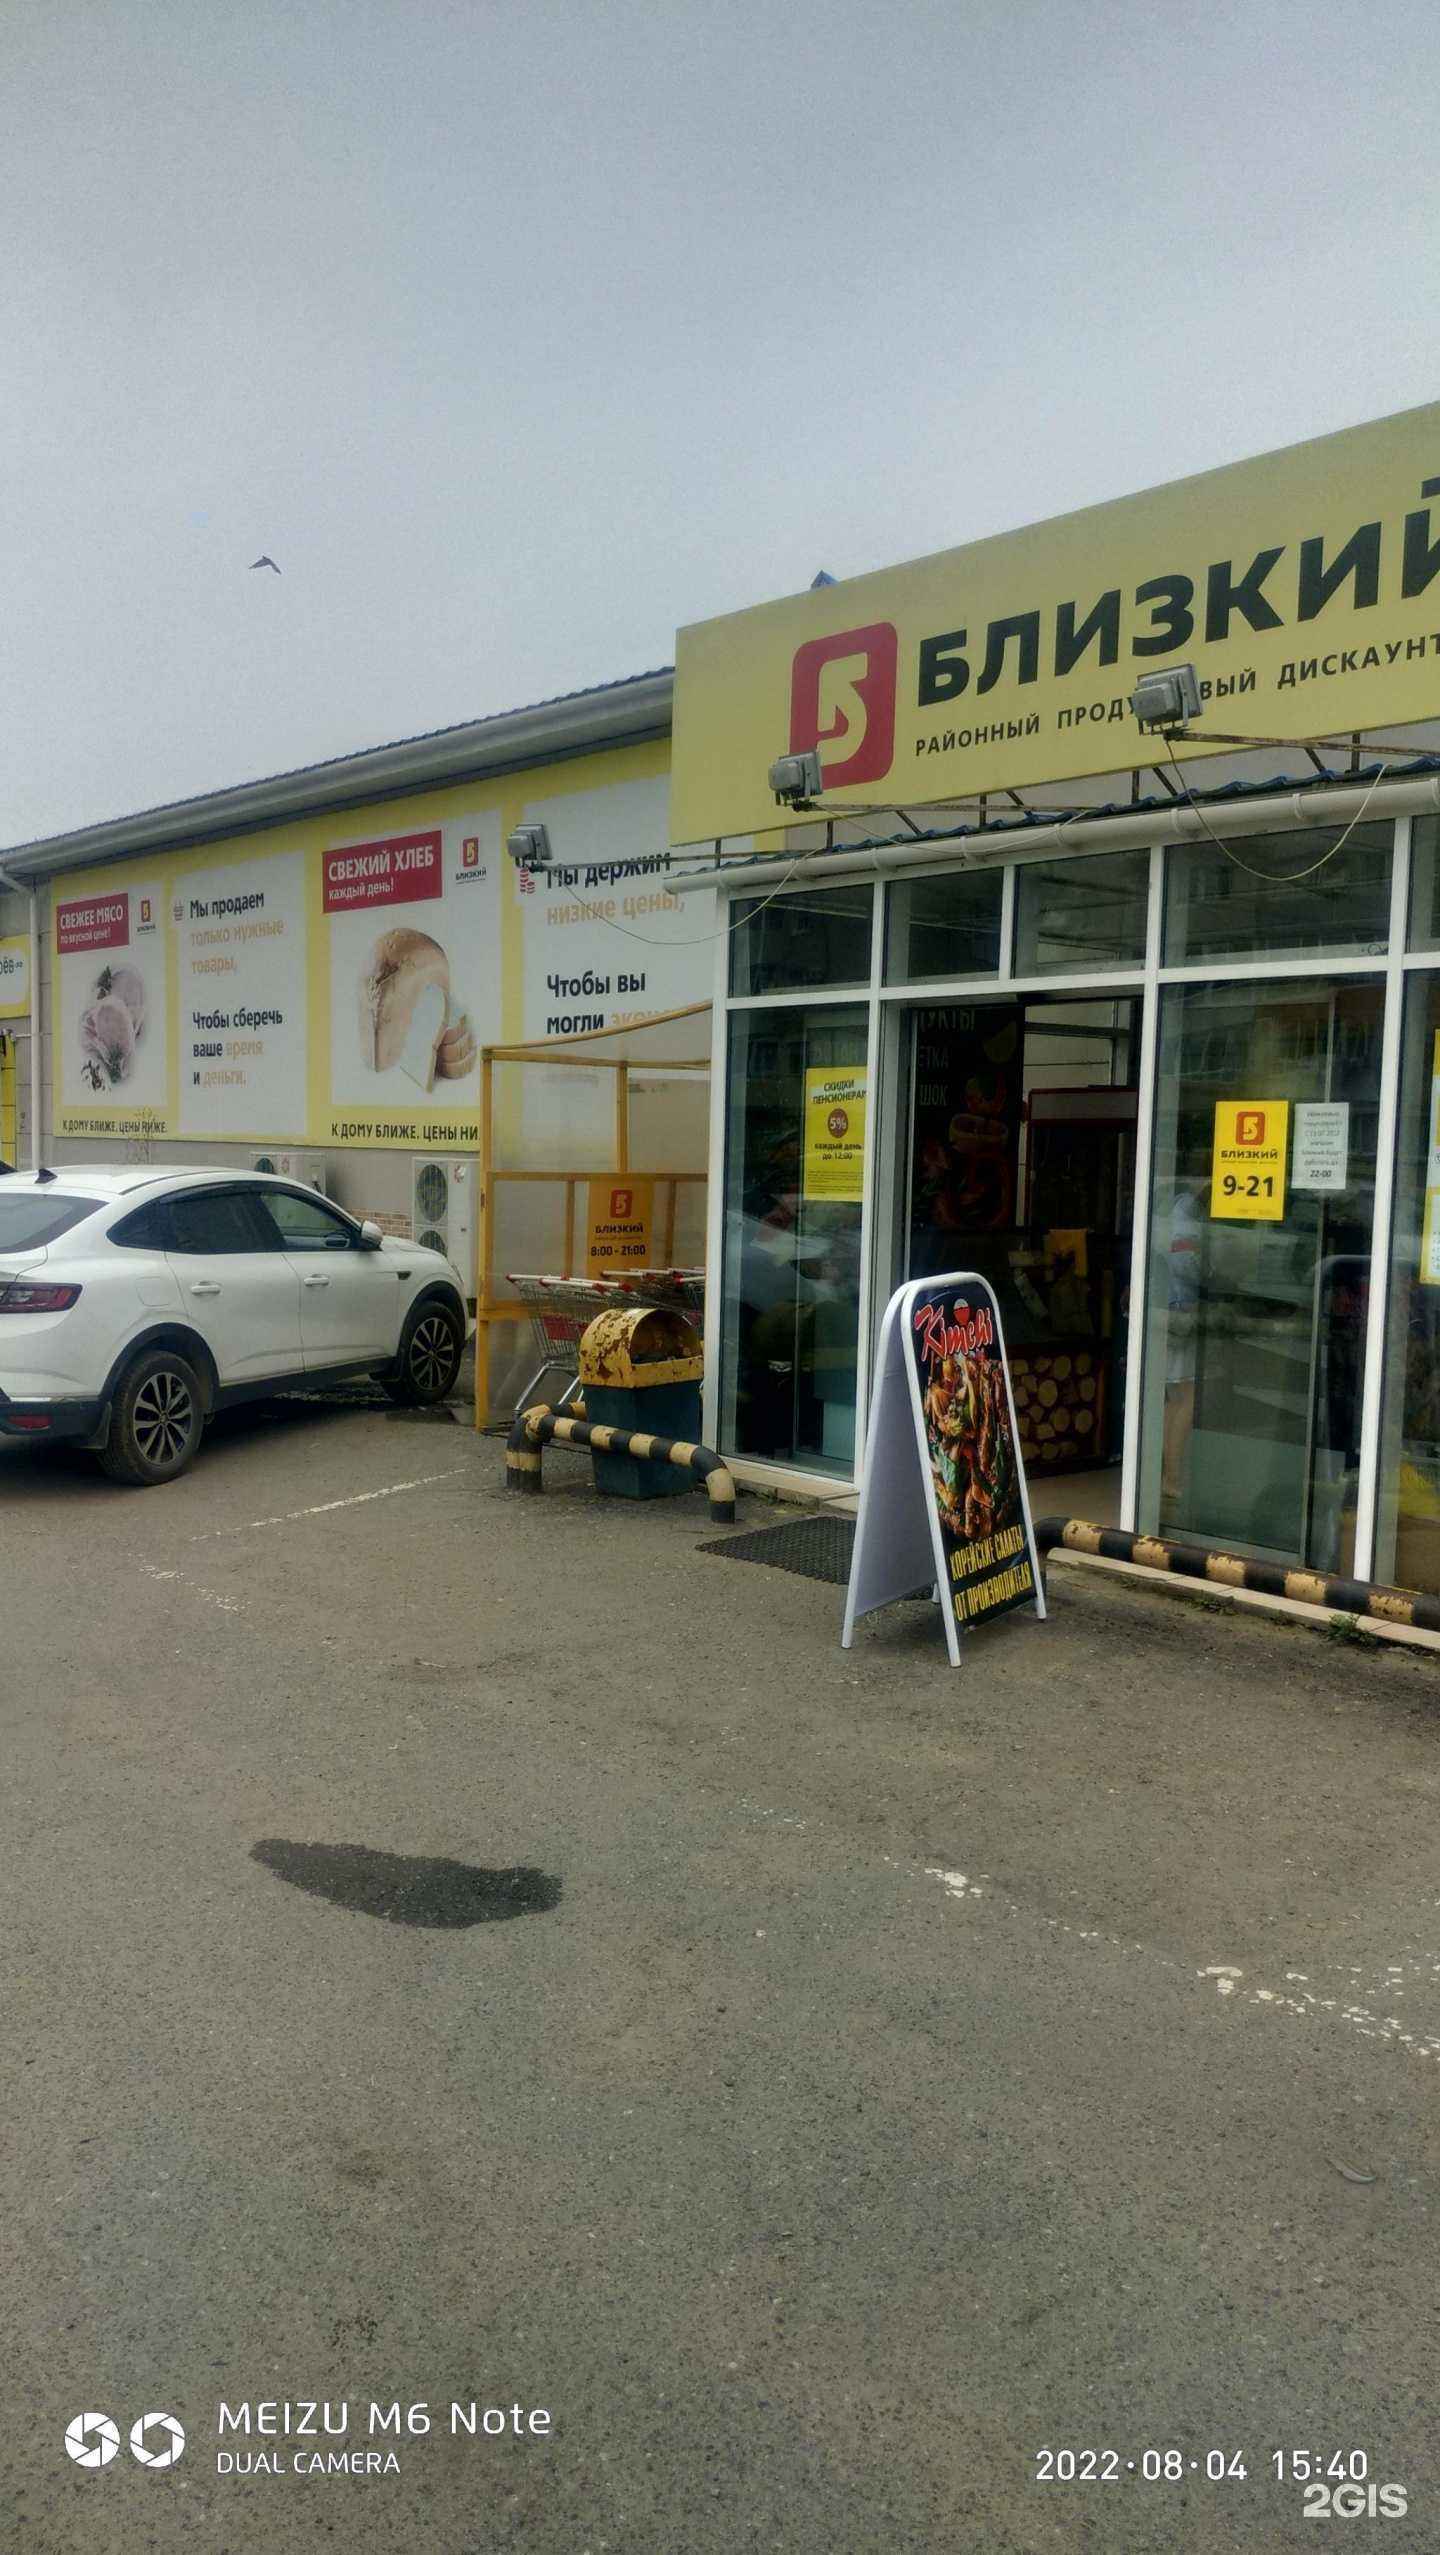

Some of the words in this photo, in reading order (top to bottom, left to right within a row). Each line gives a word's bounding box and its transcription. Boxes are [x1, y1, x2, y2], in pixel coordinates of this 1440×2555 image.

[915, 711, 1040, 756] РАЙОННЫЙ
[1057, 668, 1257, 730] ПРОДУВЫЙ
[328, 850, 390, 882] СВЕЖИЙ
[394, 845, 434, 871] ХЛЕБ
[584, 852, 671, 888] держим
[329, 881, 366, 900] каждый
[367, 877, 394, 898] день!
[60, 910, 95, 930] СВЕЖЕЕ
[96, 904, 123, 924] МЯСО
[190, 899, 209, 919] Мы
[212, 892, 264, 919] продаем
[548, 898, 616, 926] низкие
[623, 892, 686, 920] цены,
[191, 927, 230, 947] только
[233, 919, 284, 944] нужные
[547, 970, 611, 998] Чтобы
[617, 972, 646, 993] вы
[193, 1009, 230, 1030] Чтобы
[233, 1007, 283, 1032] сберечь
[547, 1014, 604, 1034] могли
[193, 1042, 223, 1057] ваше
[193, 1071, 200, 1085] и
[823, 1080, 855, 1092] СКИДКИ
[68, 1119, 89, 1132] ДОМУ
[119, 1120, 141, 1135] ЦЕНЫ
[331, 1123, 338, 1136] К
[341, 1123, 372, 1139] ДОМУ
[375, 1124, 420, 1140] БЛИЖЕ.
[423, 1125, 457, 1142] ЦЕНЫ
[460, 1125, 480, 1141] НИ
[829, 1117, 847, 1130] 5%
[1220, 1148, 1279, 1160] БЛИЗКИЙ
[1223, 1174, 1274, 1198] 9-21
[595, 1221, 644, 1234] БЛИЗКИЙ
[949, 1537, 996, 1581] КОРЕЙСКИЕ
[994, 1524, 1025, 1561] САЛАТЫ
[954, 1590, 968, 1621] ОТ
[966, 1560, 1033, 1616] ПРОИЗВОДИТЕЛЯ
